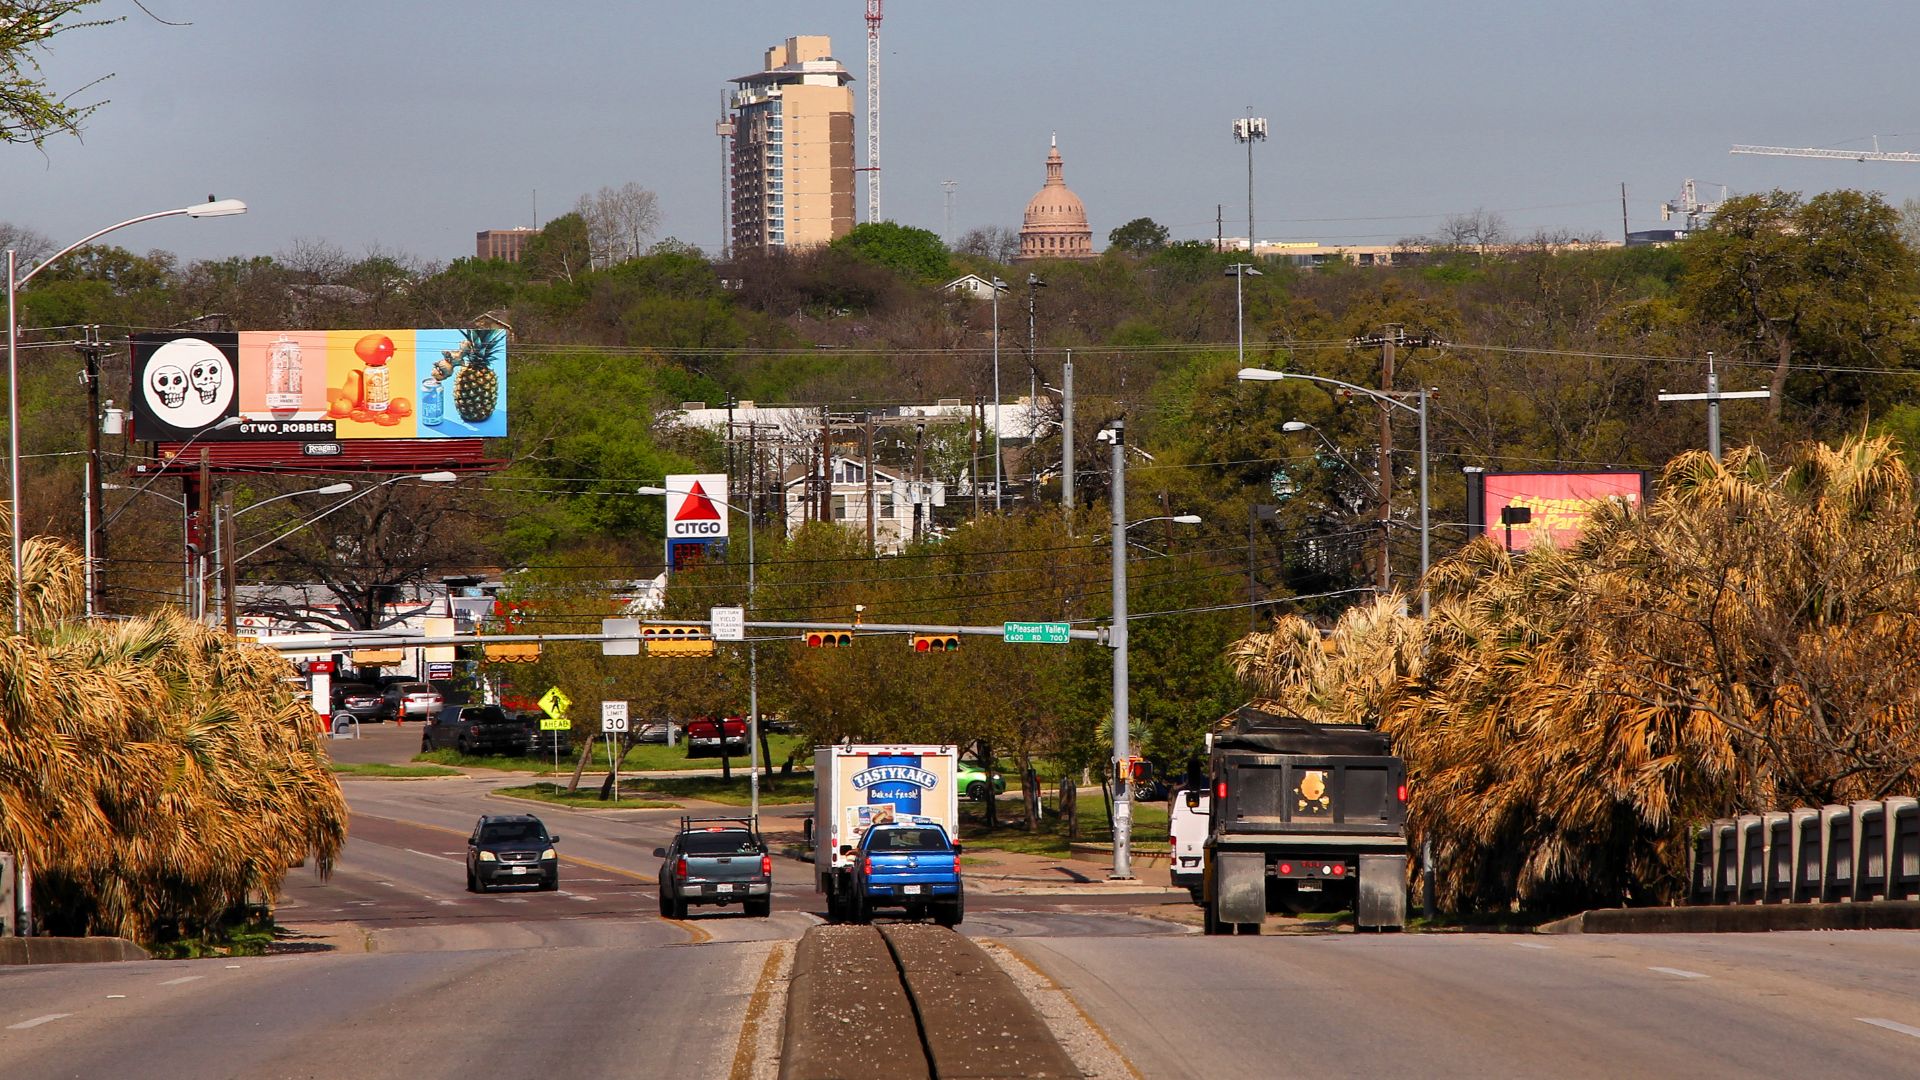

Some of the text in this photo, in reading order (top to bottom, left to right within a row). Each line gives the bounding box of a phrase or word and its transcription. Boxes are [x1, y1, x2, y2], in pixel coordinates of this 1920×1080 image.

[240, 423, 334, 435] @TWO_ROBBERS
[309, 445, 337, 453] Reagan
[675, 522, 721, 534] CITGO
[1491, 514, 1599, 531] Ao Part
[1013, 624, 1043, 633] Pleasant
[1045, 625, 1066, 635] Valley
[606, 718, 625, 730] 30
[854, 767, 935, 787] TASTYKAKE
[871, 789, 918, 799] Baked fresh!
